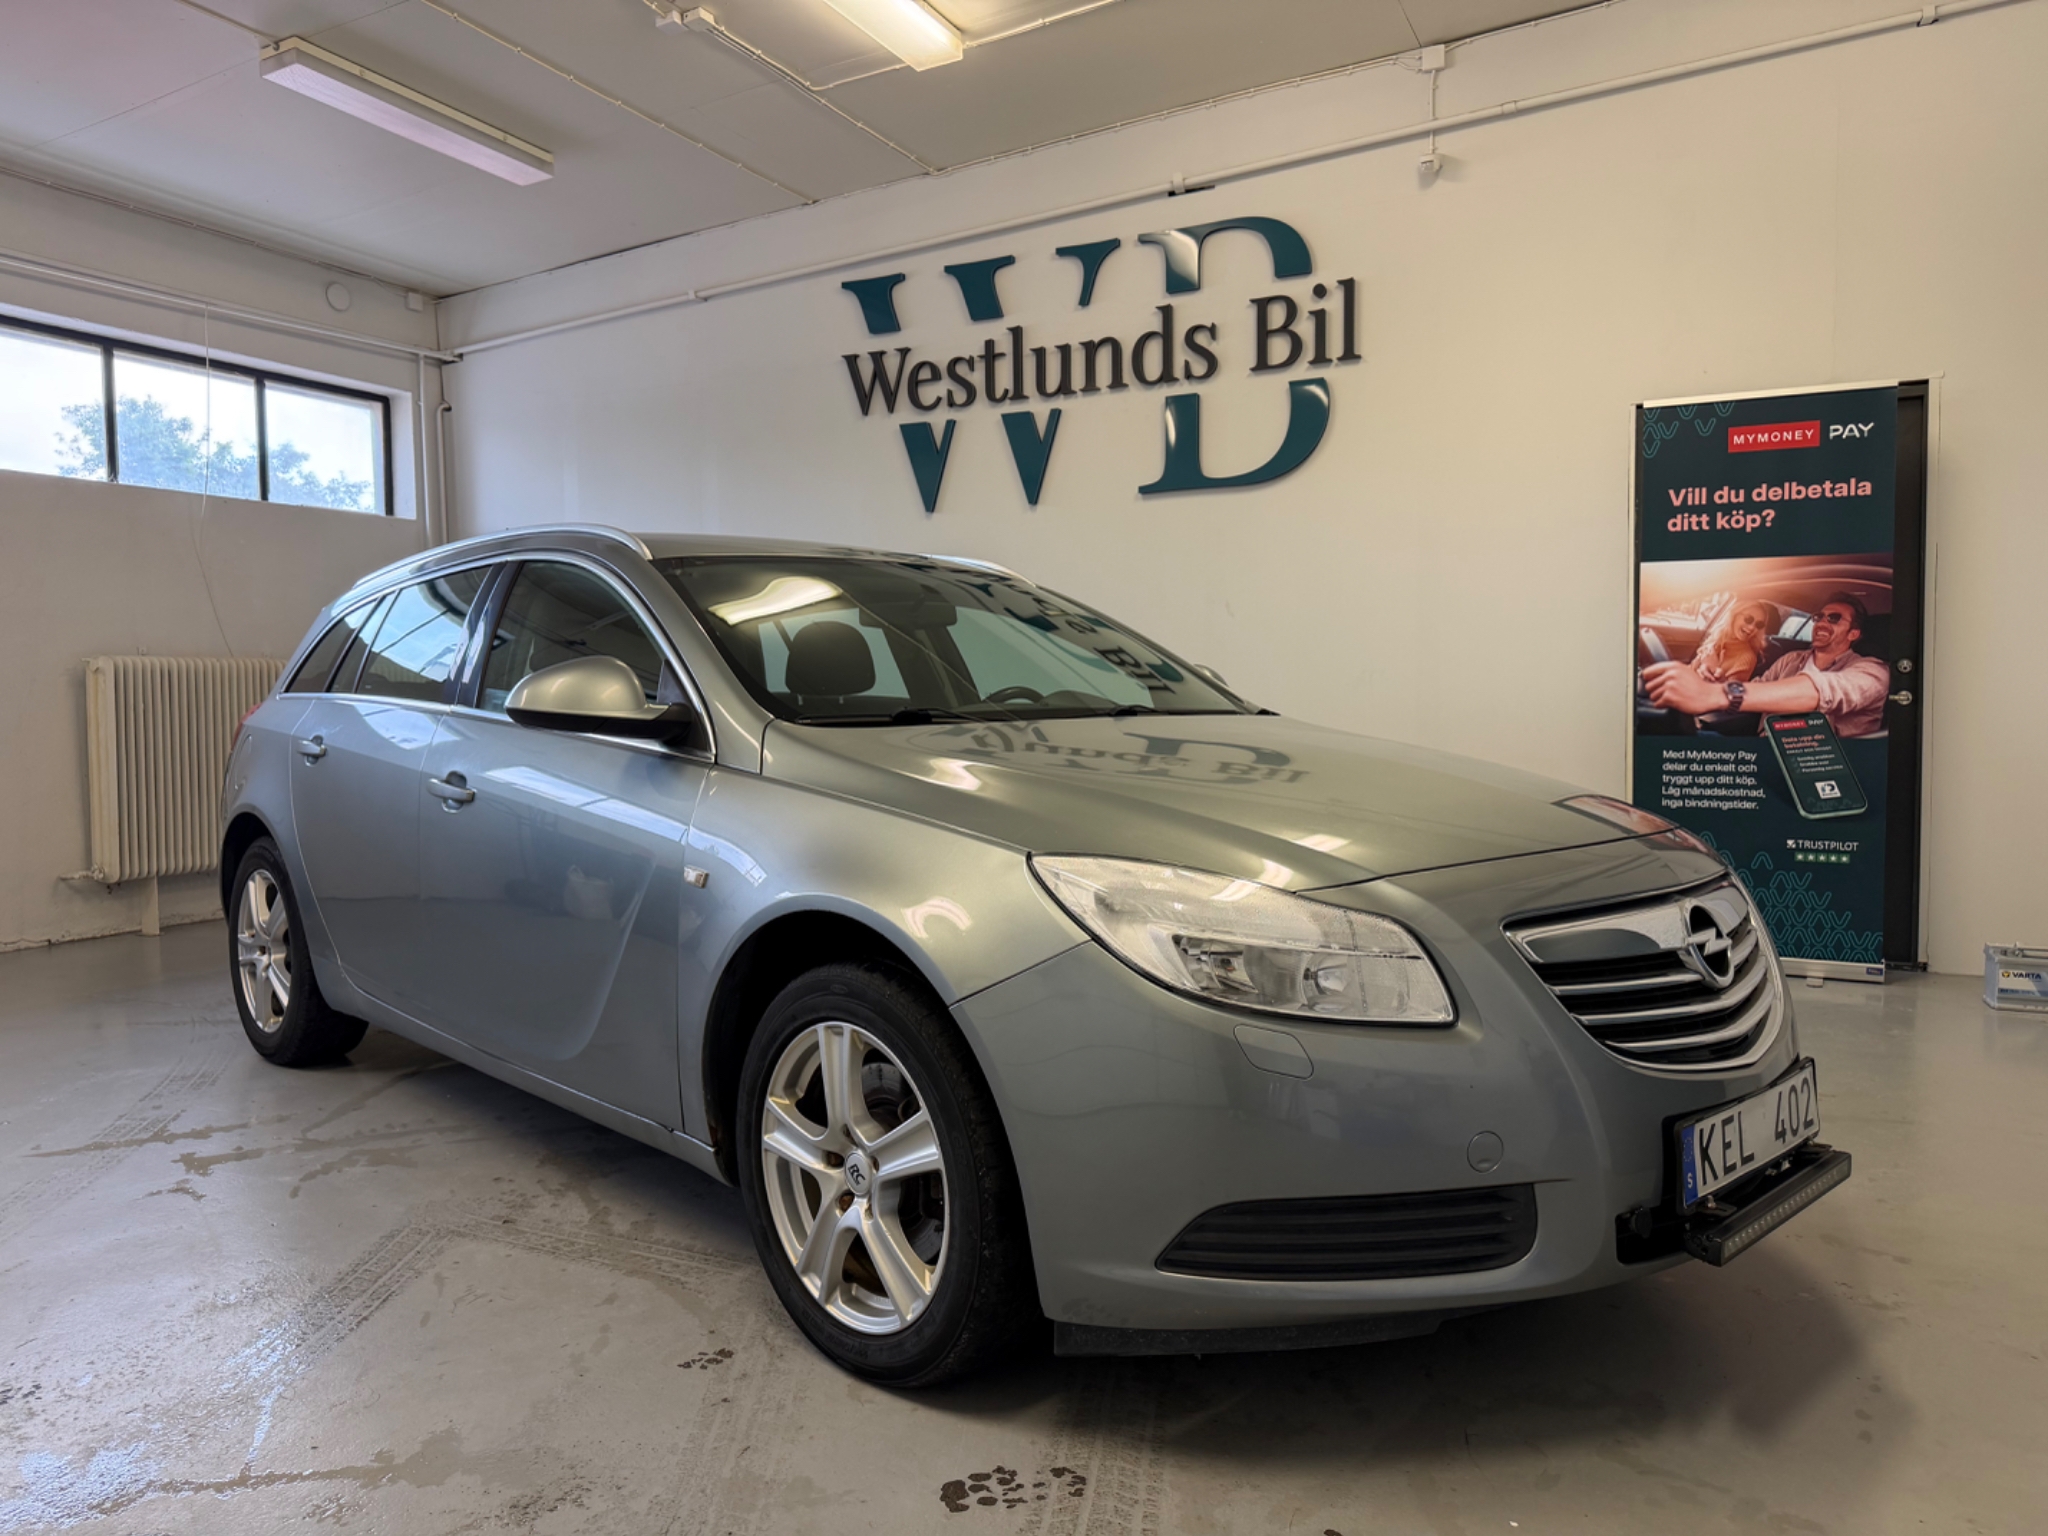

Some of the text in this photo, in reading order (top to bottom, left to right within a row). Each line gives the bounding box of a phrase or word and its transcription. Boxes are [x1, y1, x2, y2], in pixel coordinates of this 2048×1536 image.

[842, 277, 1361, 416] Westlunds Bil
[1733, 422, 1875, 445] MYMONEY PAY
[1668, 477, 1873, 507] Vill du delbetala
[1667, 508, 1776, 533] ditt köp?
[1663, 749, 1757, 762] Med MyMoney Pay
[1662, 762, 1757, 772] delar du enkelt och
[1662, 774, 1757, 786] tryggt upp ditt köp.
[1661, 786, 1766, 798] Låg månadskostnad,
[1685, 798, 1759, 810] bindningstider.
[1797, 839, 1859, 851] TRUSTPILOT
[2011, 971, 2042, 980] VARTA
[1699, 1076, 1815, 1187] KEL 402
[1687, 1172, 1693, 1189] S
